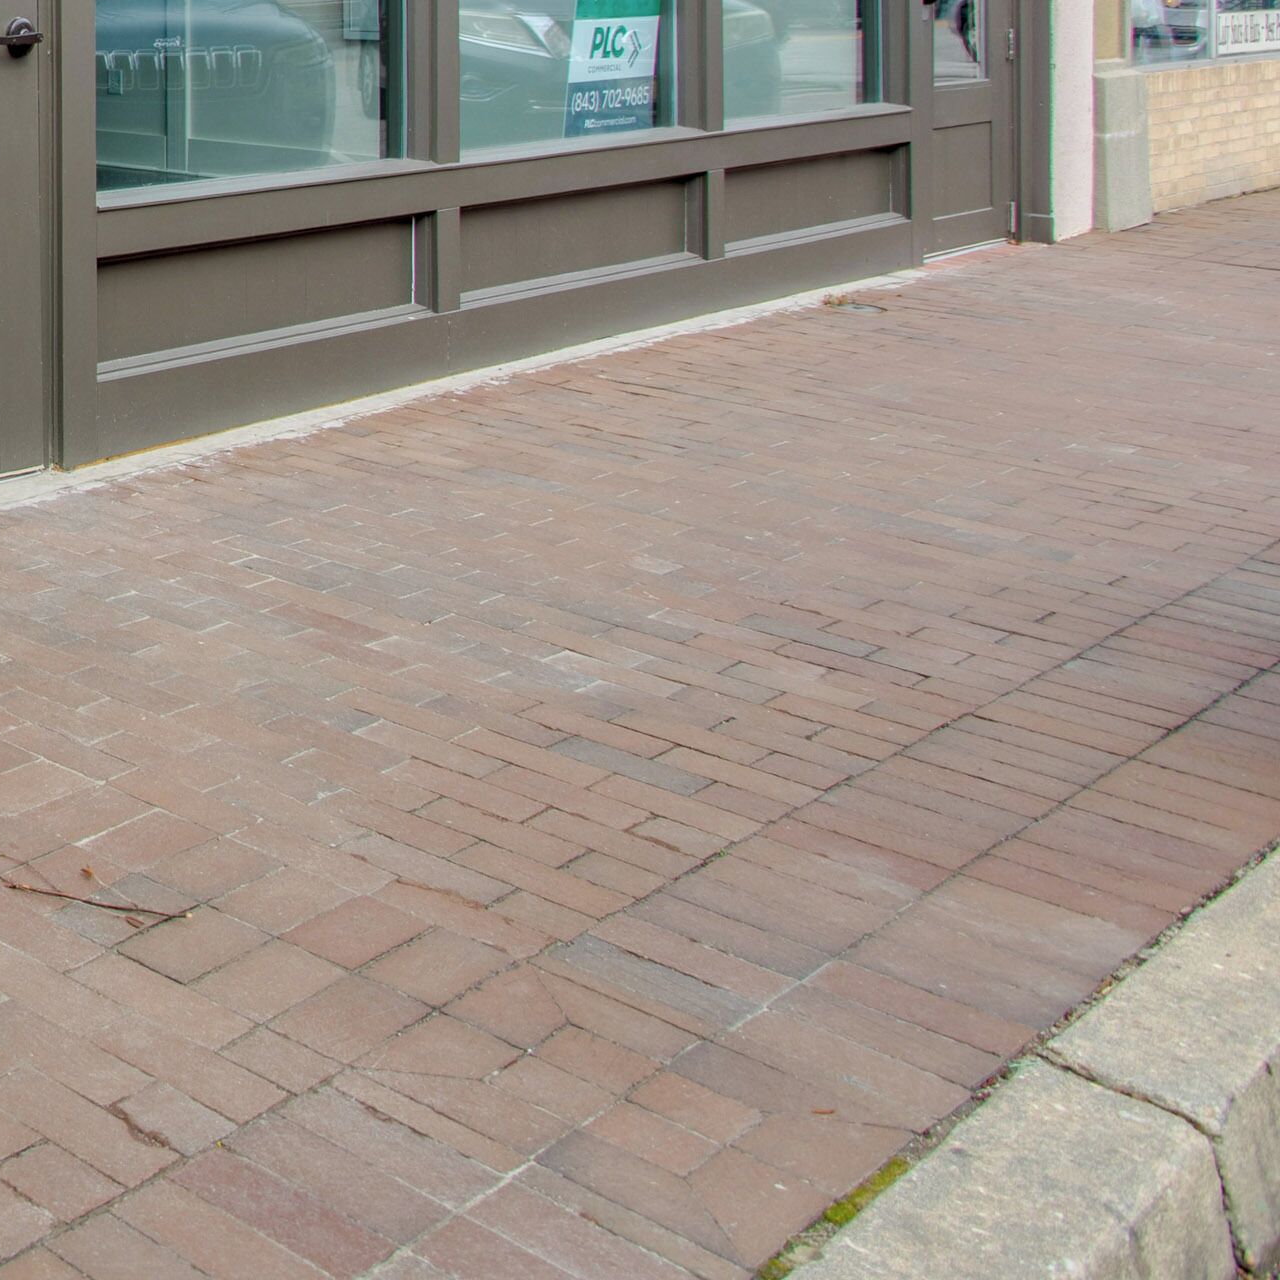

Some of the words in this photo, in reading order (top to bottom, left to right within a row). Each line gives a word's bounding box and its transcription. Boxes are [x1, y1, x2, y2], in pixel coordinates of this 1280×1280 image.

[589, 25, 627, 59] PLC
[588, 64, 621, 74] COMMERCIAL
[572, 91, 599, 115] (843)
[602, 86, 650, 110] 702-9685
